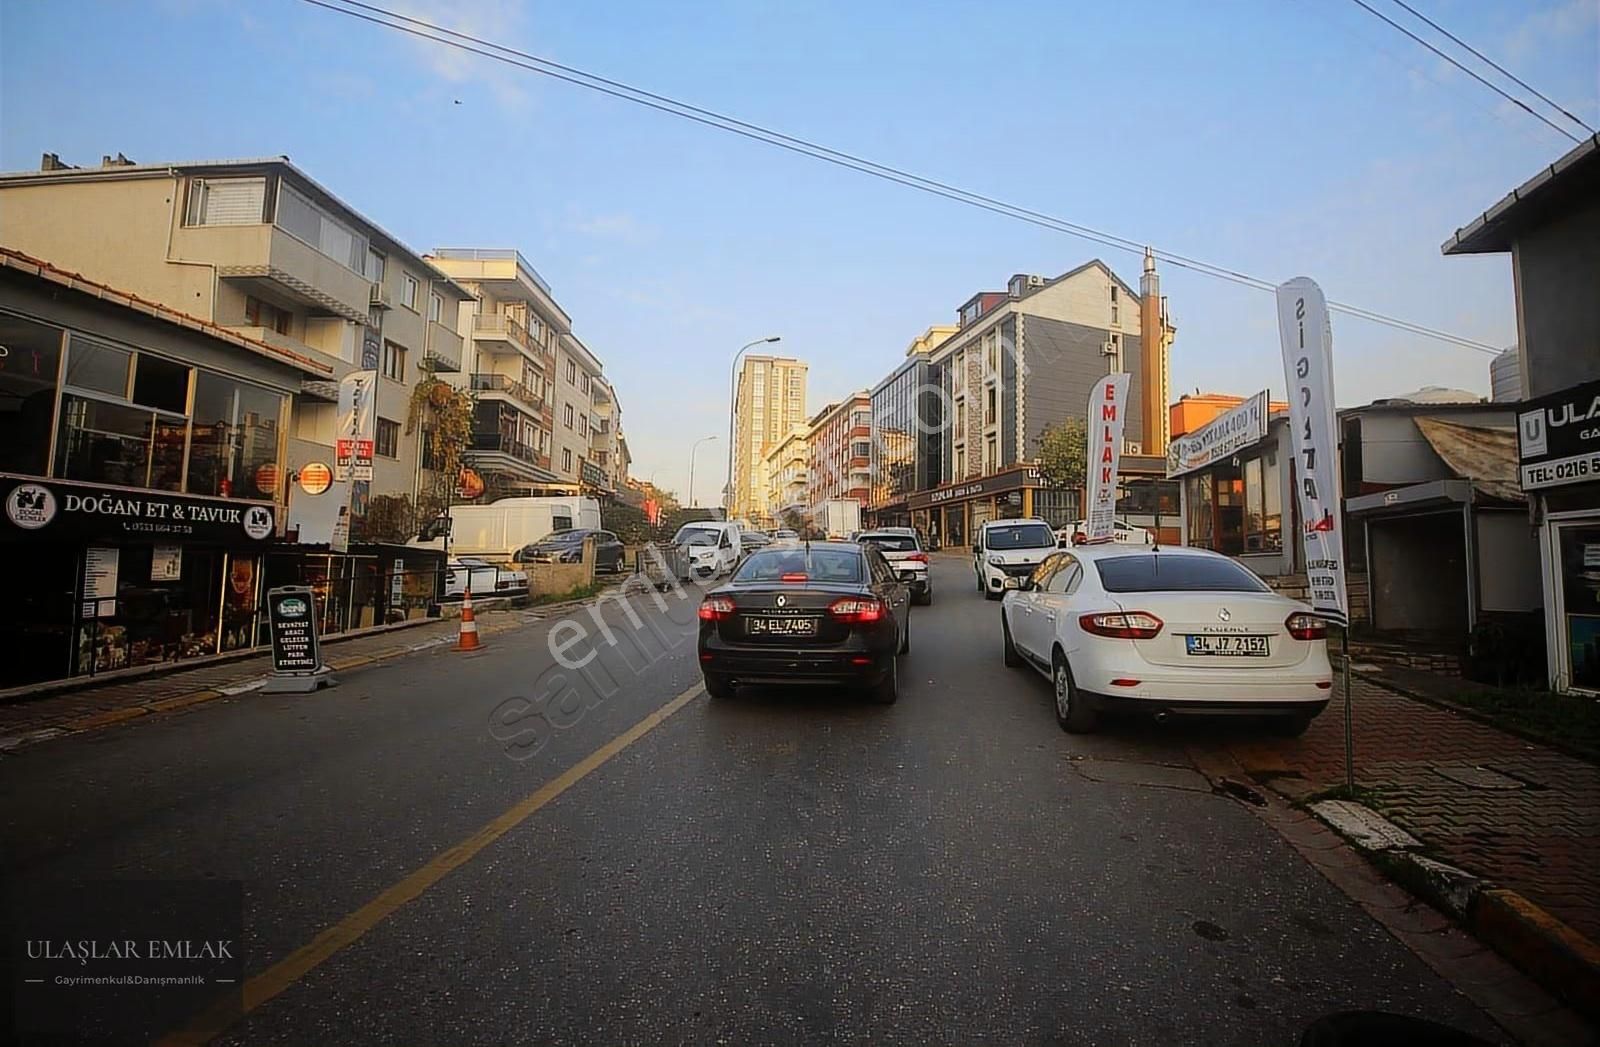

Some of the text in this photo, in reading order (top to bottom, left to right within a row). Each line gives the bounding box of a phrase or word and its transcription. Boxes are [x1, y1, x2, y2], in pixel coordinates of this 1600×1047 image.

[1101, 384, 1117, 485] EMLAK
[1527, 468, 1554, 484] TEL:
[1556, 460, 1588, 478] 0216
[64, 493, 241, 523] DOĞAN ET & TAVUK
[753, 619, 812, 630] 34 EL 7405
[1195, 637, 1266, 651] 34 JZ 2152
